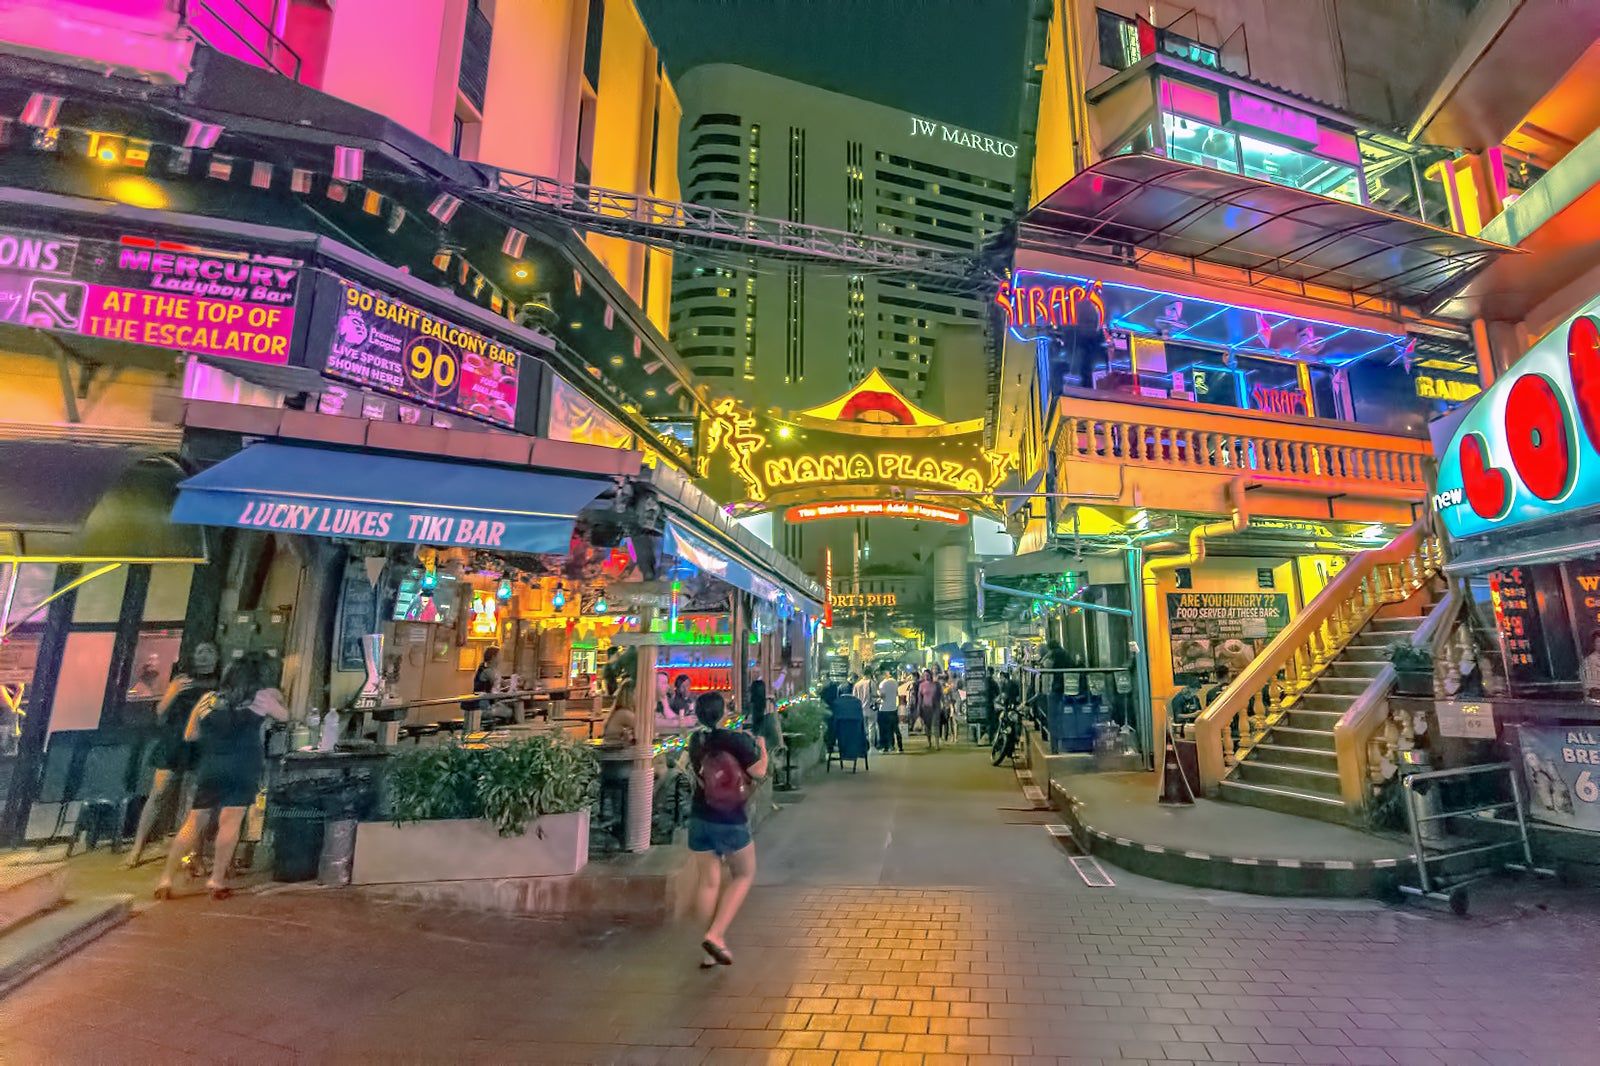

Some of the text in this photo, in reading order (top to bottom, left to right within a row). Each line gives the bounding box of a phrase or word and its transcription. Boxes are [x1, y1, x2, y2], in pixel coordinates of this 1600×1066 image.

[910, 117, 1018, 158] JW MARRIO
[118, 249, 297, 289] MERCURY
[152, 274, 292, 303] Ladyboy Bar
[103, 291, 281, 329] AT THE TOP OF
[90, 316, 288, 355] THE ESCALATOR
[347, 288, 516, 368] 90 BAHT BALCONY BAR
[370, 327, 402, 344] Premier
[328, 355, 405, 387] SHOWN HERE!
[333, 344, 402, 373] LIVE SPORTS
[410, 345, 456, 387] 90
[765, 453, 984, 492] NANA PLAZA
[1432, 487, 1462, 511] new
[238, 501, 505, 546] LUCKY LUKES TIKI BAR
[866, 593, 896, 606] PUB
[1177, 608, 1198, 619] FOOD
[1199, 608, 1227, 618] SERVED
[1228, 608, 1236, 618] AT
[1237, 608, 1259, 618] THESE
[1180, 594, 1275, 608] ARE YOU HUNGRY ??
[1567, 732, 1597, 745] ALL
